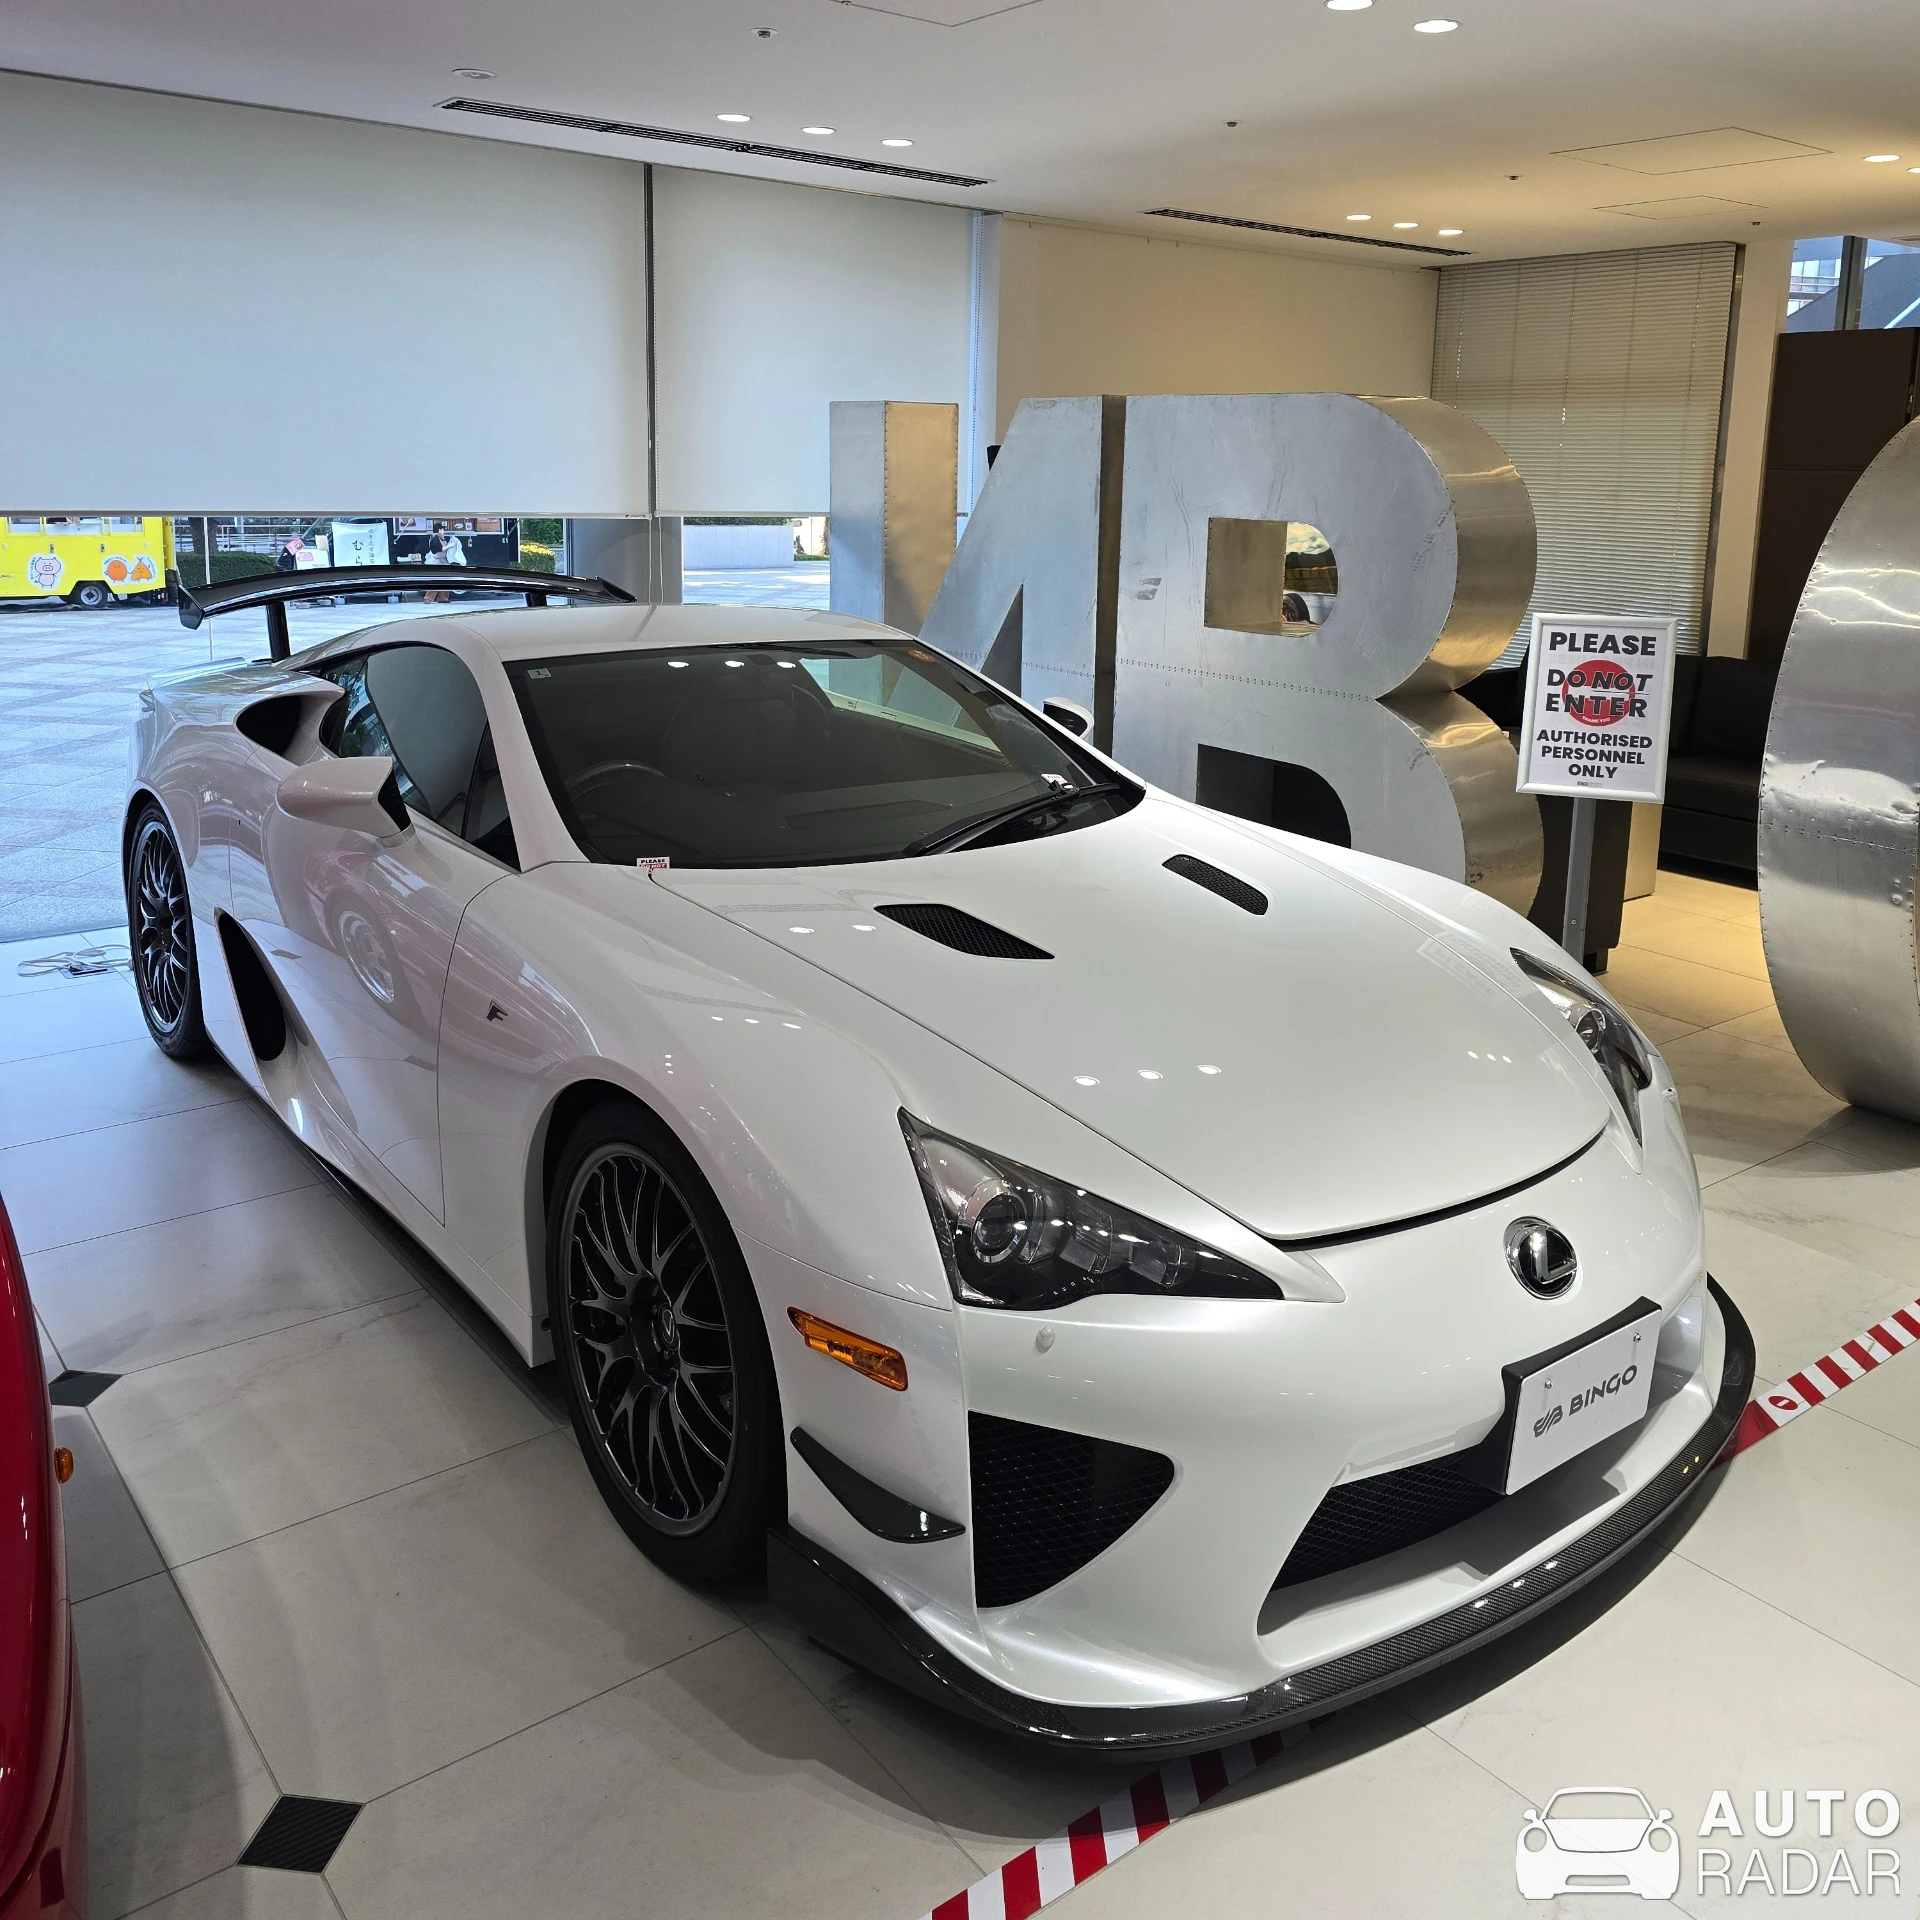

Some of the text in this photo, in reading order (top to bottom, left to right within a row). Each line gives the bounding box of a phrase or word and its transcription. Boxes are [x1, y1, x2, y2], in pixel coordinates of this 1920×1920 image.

[1549, 631, 1657, 656] PLEASE
[1547, 668, 1653, 692] DO NOT
[1545, 693, 1648, 718] ENTER
[1536, 729, 1653, 748] AUTHORISED
[1541, 745, 1646, 765] PERSONNEL
[1568, 763, 1619, 779] ONLY
[1568, 1364, 1638, 1417] BINGO
